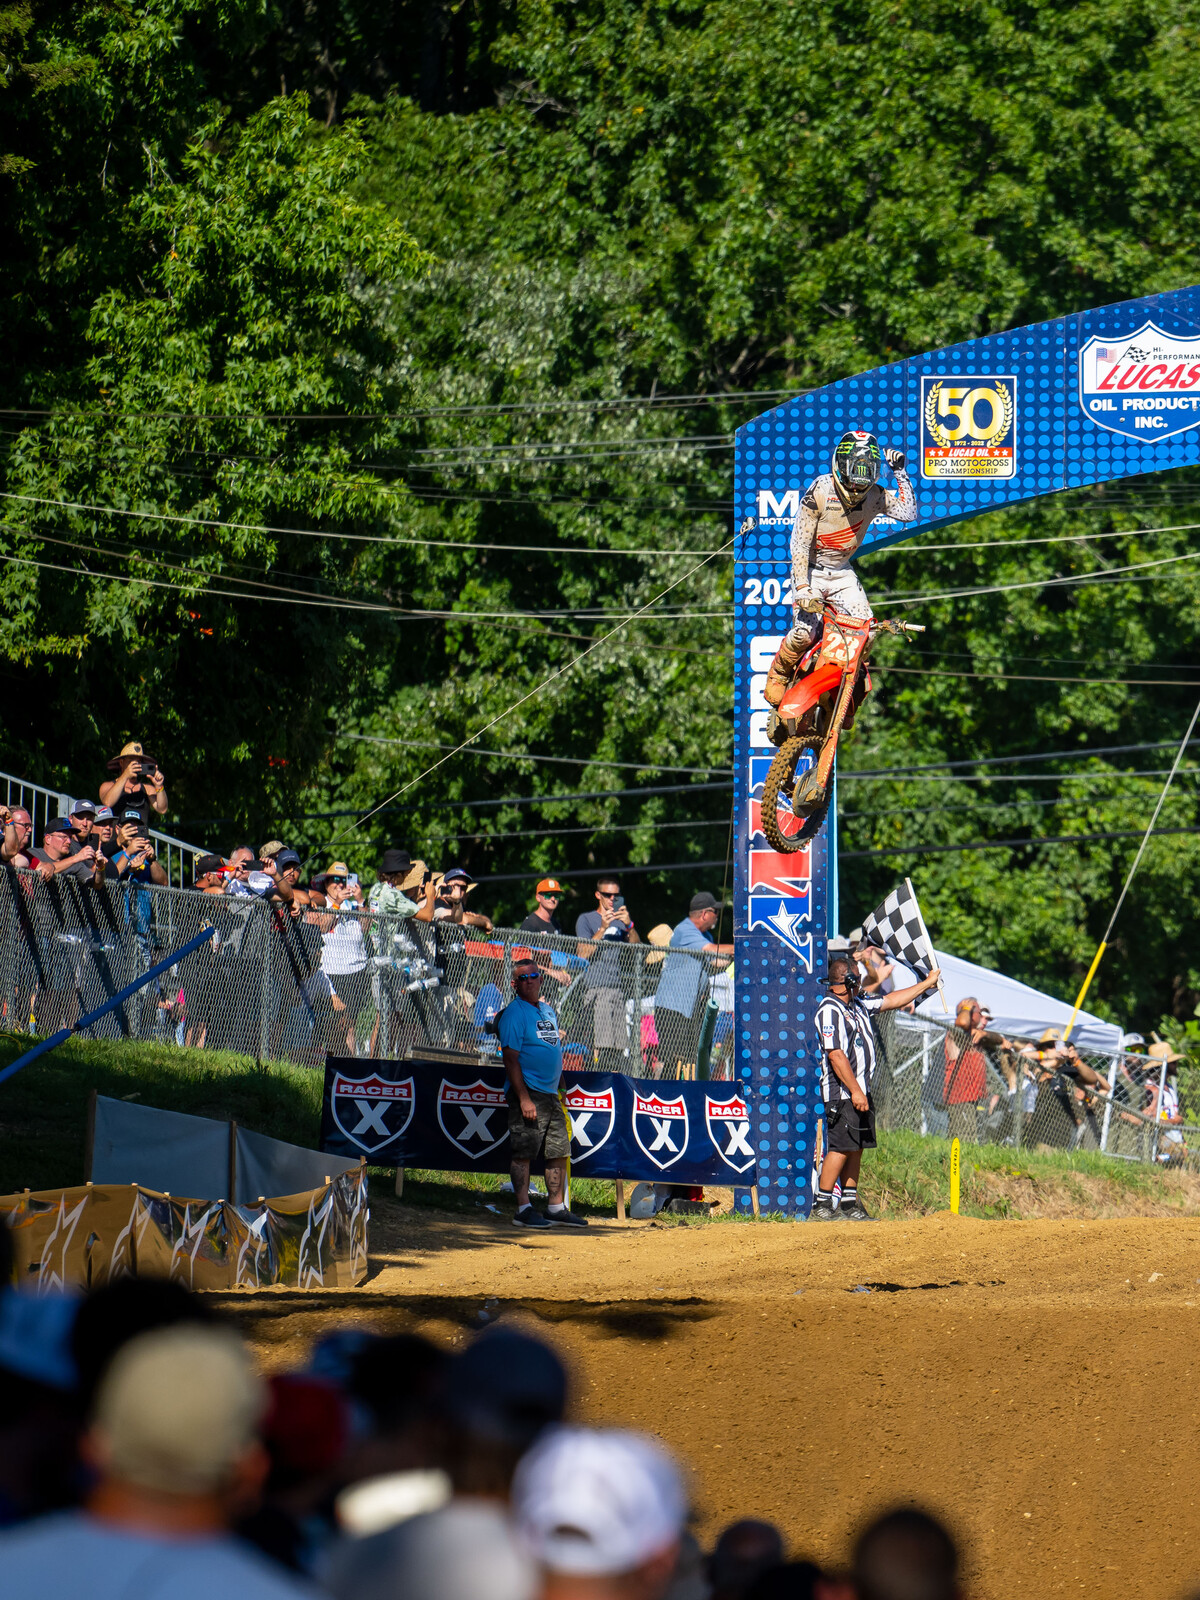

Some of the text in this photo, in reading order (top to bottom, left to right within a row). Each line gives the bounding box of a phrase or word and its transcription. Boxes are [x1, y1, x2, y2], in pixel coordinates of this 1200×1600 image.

[936, 387, 1005, 441] 50
[1089, 398, 1118, 412] OIL
[1134, 416, 1168, 429] INC.
[928, 459, 1009, 467] PRO MOTOCROSS
[948, 448, 990, 457] LUCAS OIL
[744, 578, 793, 605] 202
[823, 632, 860, 662] 23
[339, 1085, 409, 1097] RACER
[565, 1097, 609, 1108] CER
[351, 1100, 393, 1136] X
[639, 1101, 682, 1115] RACER
[456, 1106, 497, 1142] X
[567, 1112, 594, 1147] X
[648, 1116, 680, 1152] X
[724, 1121, 756, 1156] X
